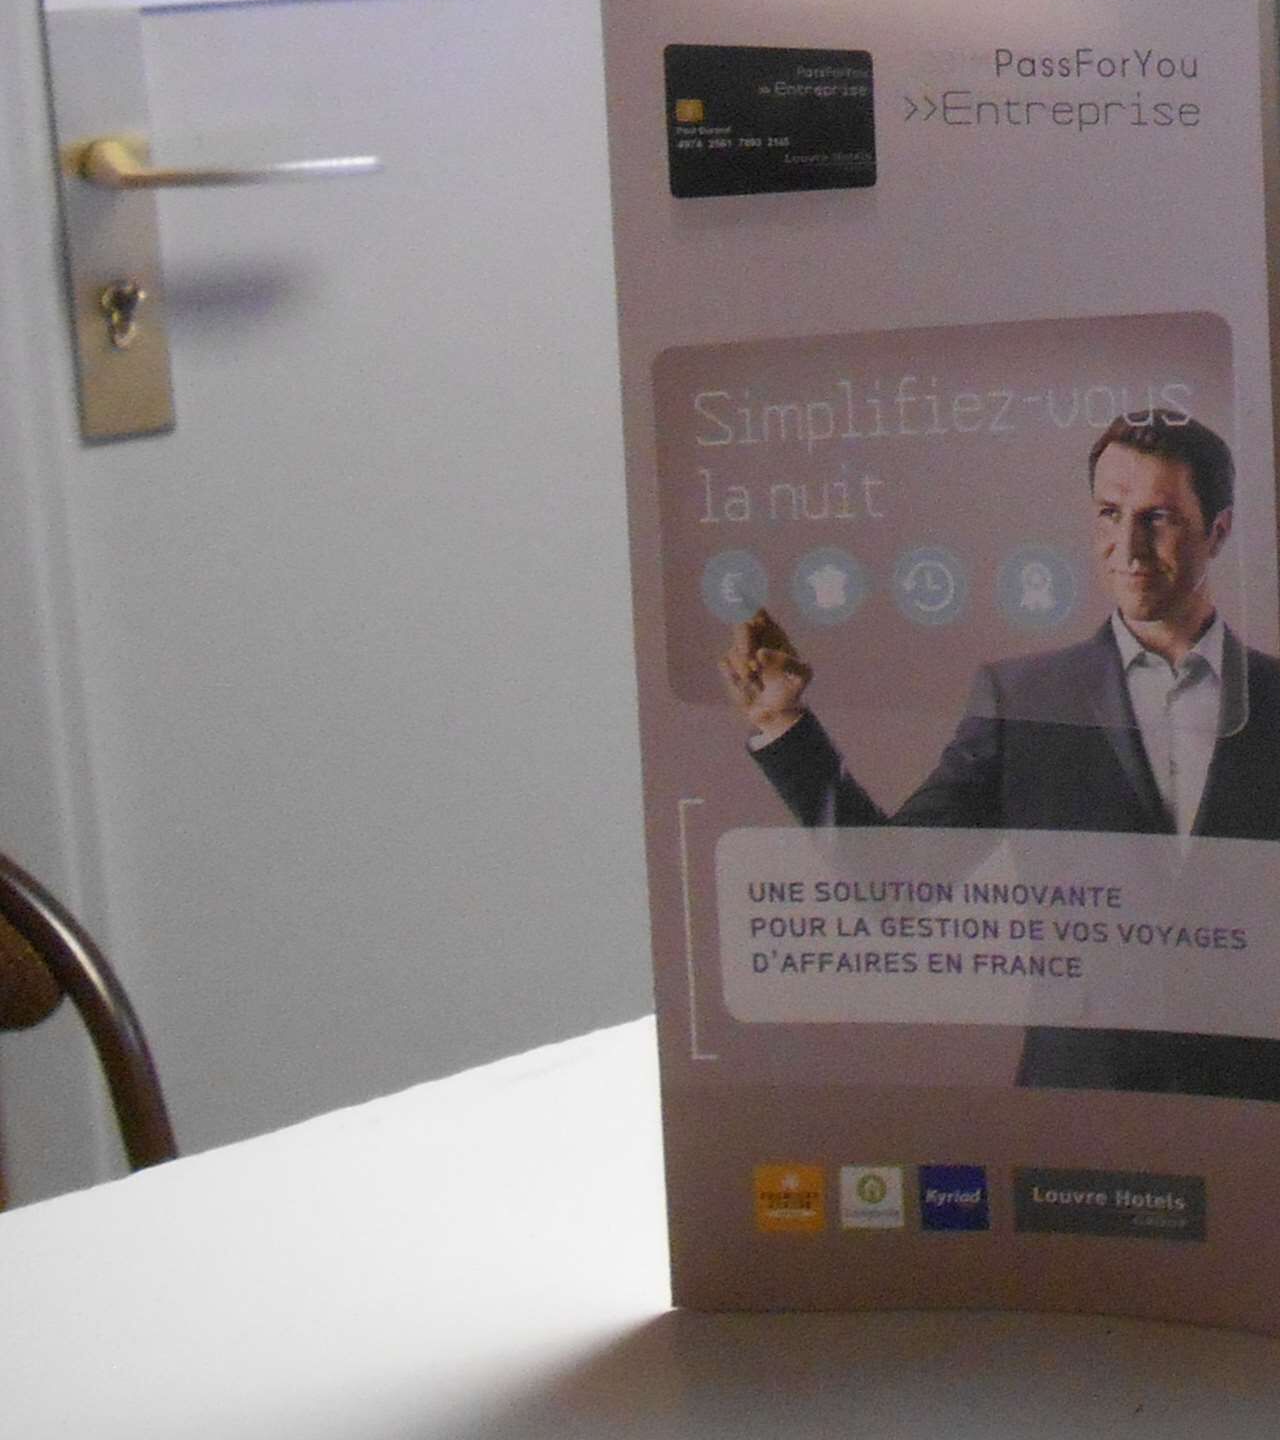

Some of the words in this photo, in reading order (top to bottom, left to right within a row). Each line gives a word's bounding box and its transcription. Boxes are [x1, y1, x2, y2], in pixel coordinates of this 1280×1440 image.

[995, 49, 1198, 79] PassForYou
[694, 376, 1195, 450] Simplifiez-vous
[698, 468, 750, 524] la
[768, 468, 886, 523] nuit
[749, 882, 803, 903] UNE
[815, 881, 953, 904] SOLUTION
[964, 883, 1122, 908] INNOVANTE
[751, 917, 826, 938] POUR
[837, 918, 870, 938] LA
[881, 918, 999, 940] GESTION
[1010, 920, 1043, 941] DE
[1053, 921, 1108, 944] VOS
[1118, 923, 1247, 951] VOYAGES
[752, 951, 917, 975] D'AFFAIRES
[928, 953, 963, 975] EN
[973, 954, 1083, 979] FRANCE
[925, 1189, 981, 1208] Kyriad
[1032, 1186, 1106, 1205] Louvre
[1115, 1188, 1186, 1211] Hotels
